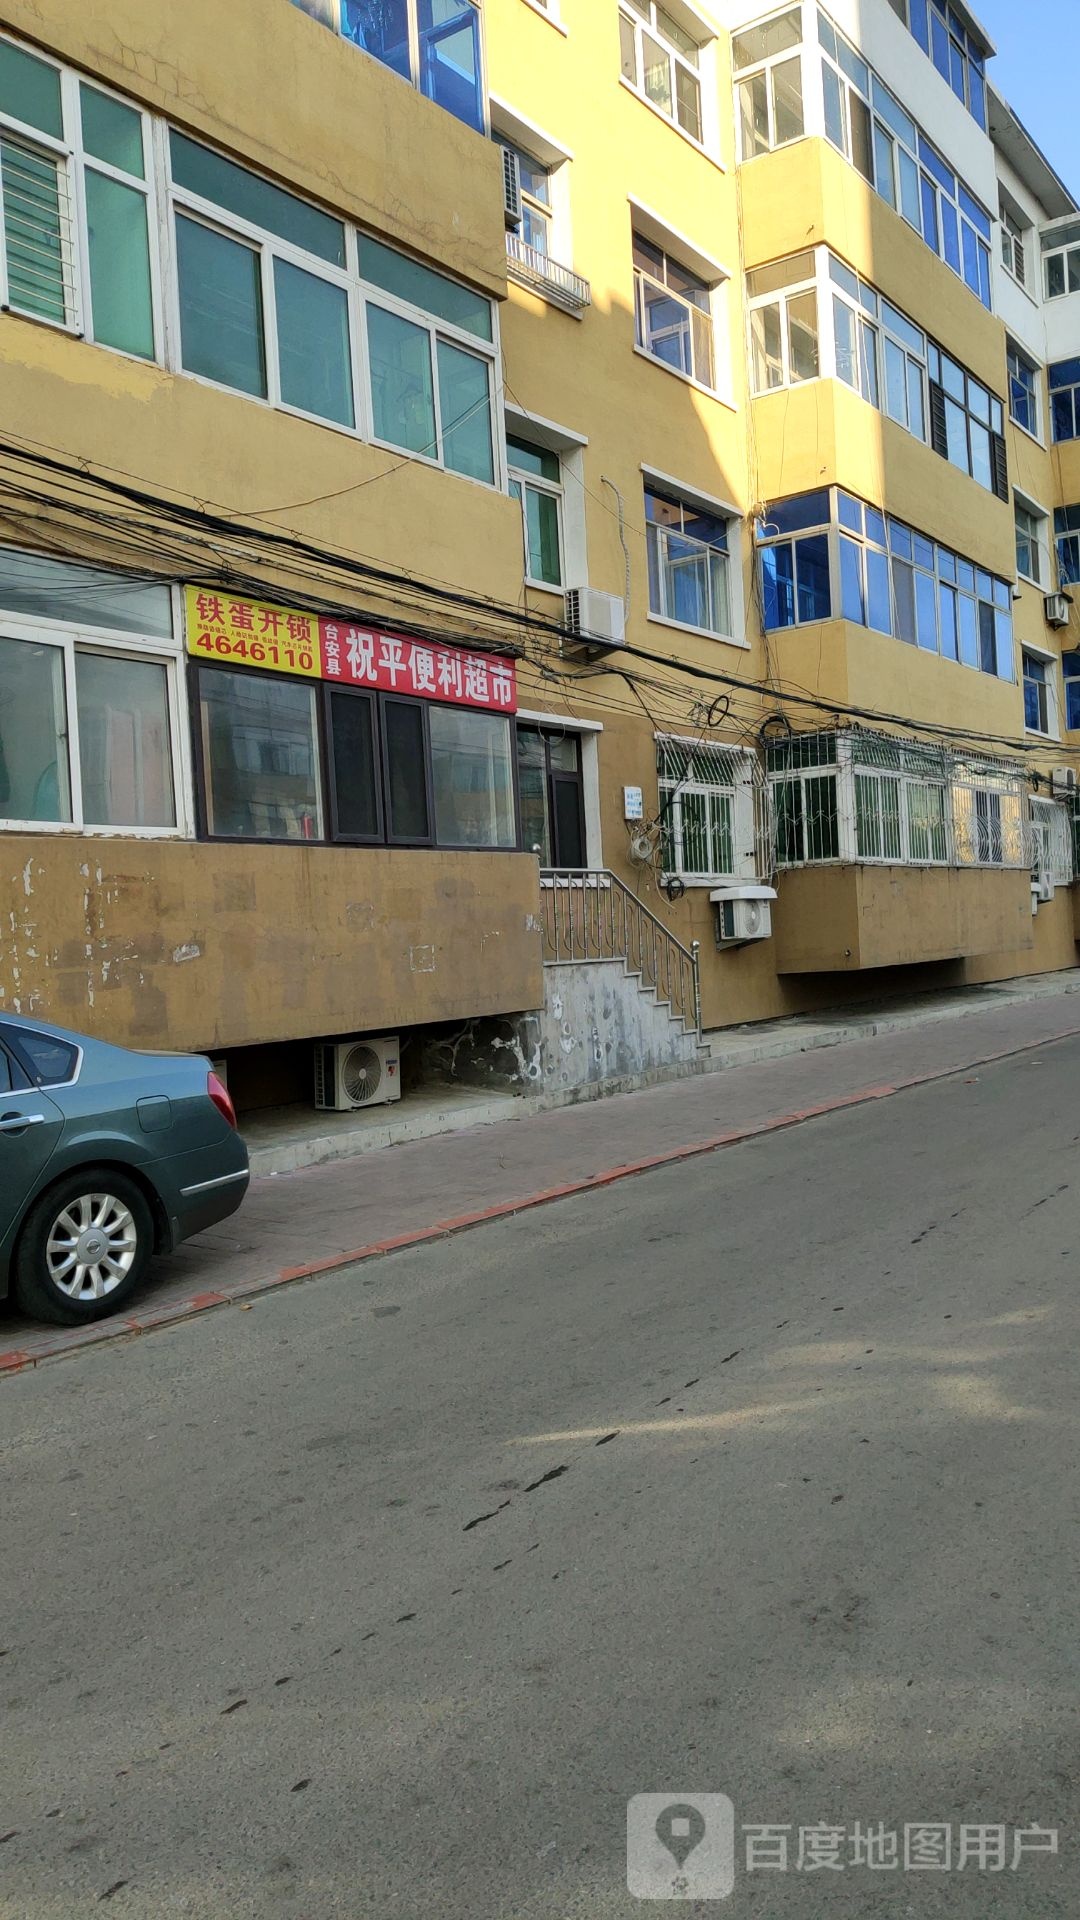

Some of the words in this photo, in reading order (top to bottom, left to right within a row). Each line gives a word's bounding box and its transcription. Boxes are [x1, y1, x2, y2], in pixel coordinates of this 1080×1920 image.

[195, 593, 312, 644] 铁蛋开锁
[196, 632, 314, 670] 4646110
[324, 623, 342, 676] 台安县
[345, 628, 513, 706] 祝平便利超市
